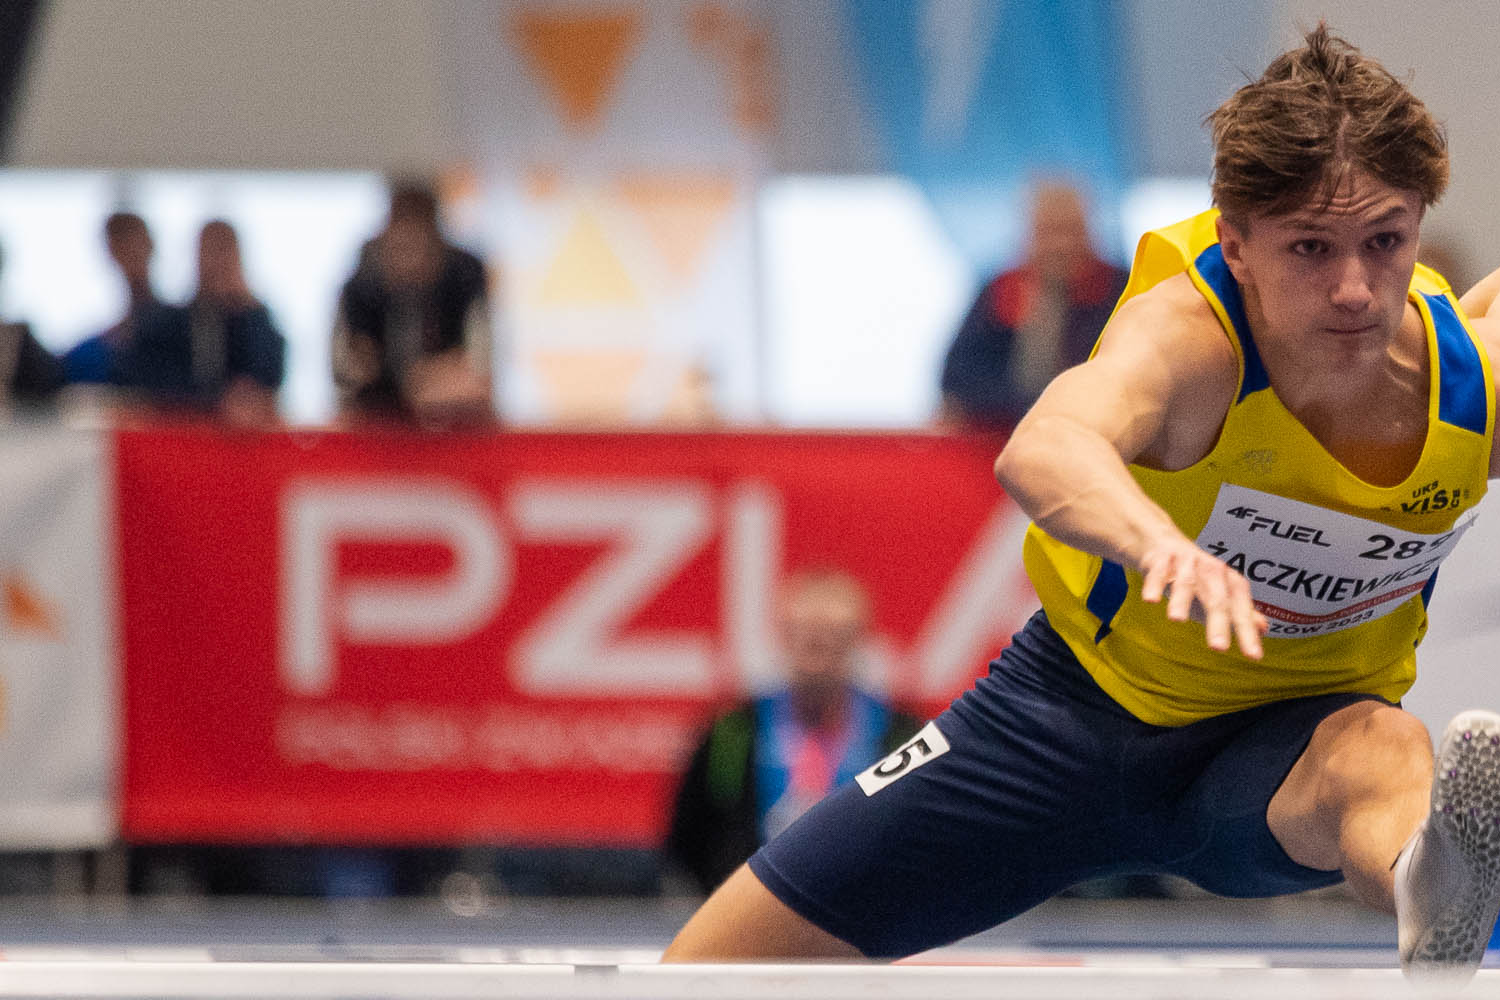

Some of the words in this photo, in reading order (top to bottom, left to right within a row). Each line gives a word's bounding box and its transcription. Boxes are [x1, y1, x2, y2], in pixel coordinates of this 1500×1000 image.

[1412, 480, 1438, 498] UKS
[1400, 489, 1449, 512] VIS
[1325, 609, 1374, 631] 2023
[873, 737, 933, 778] 5
